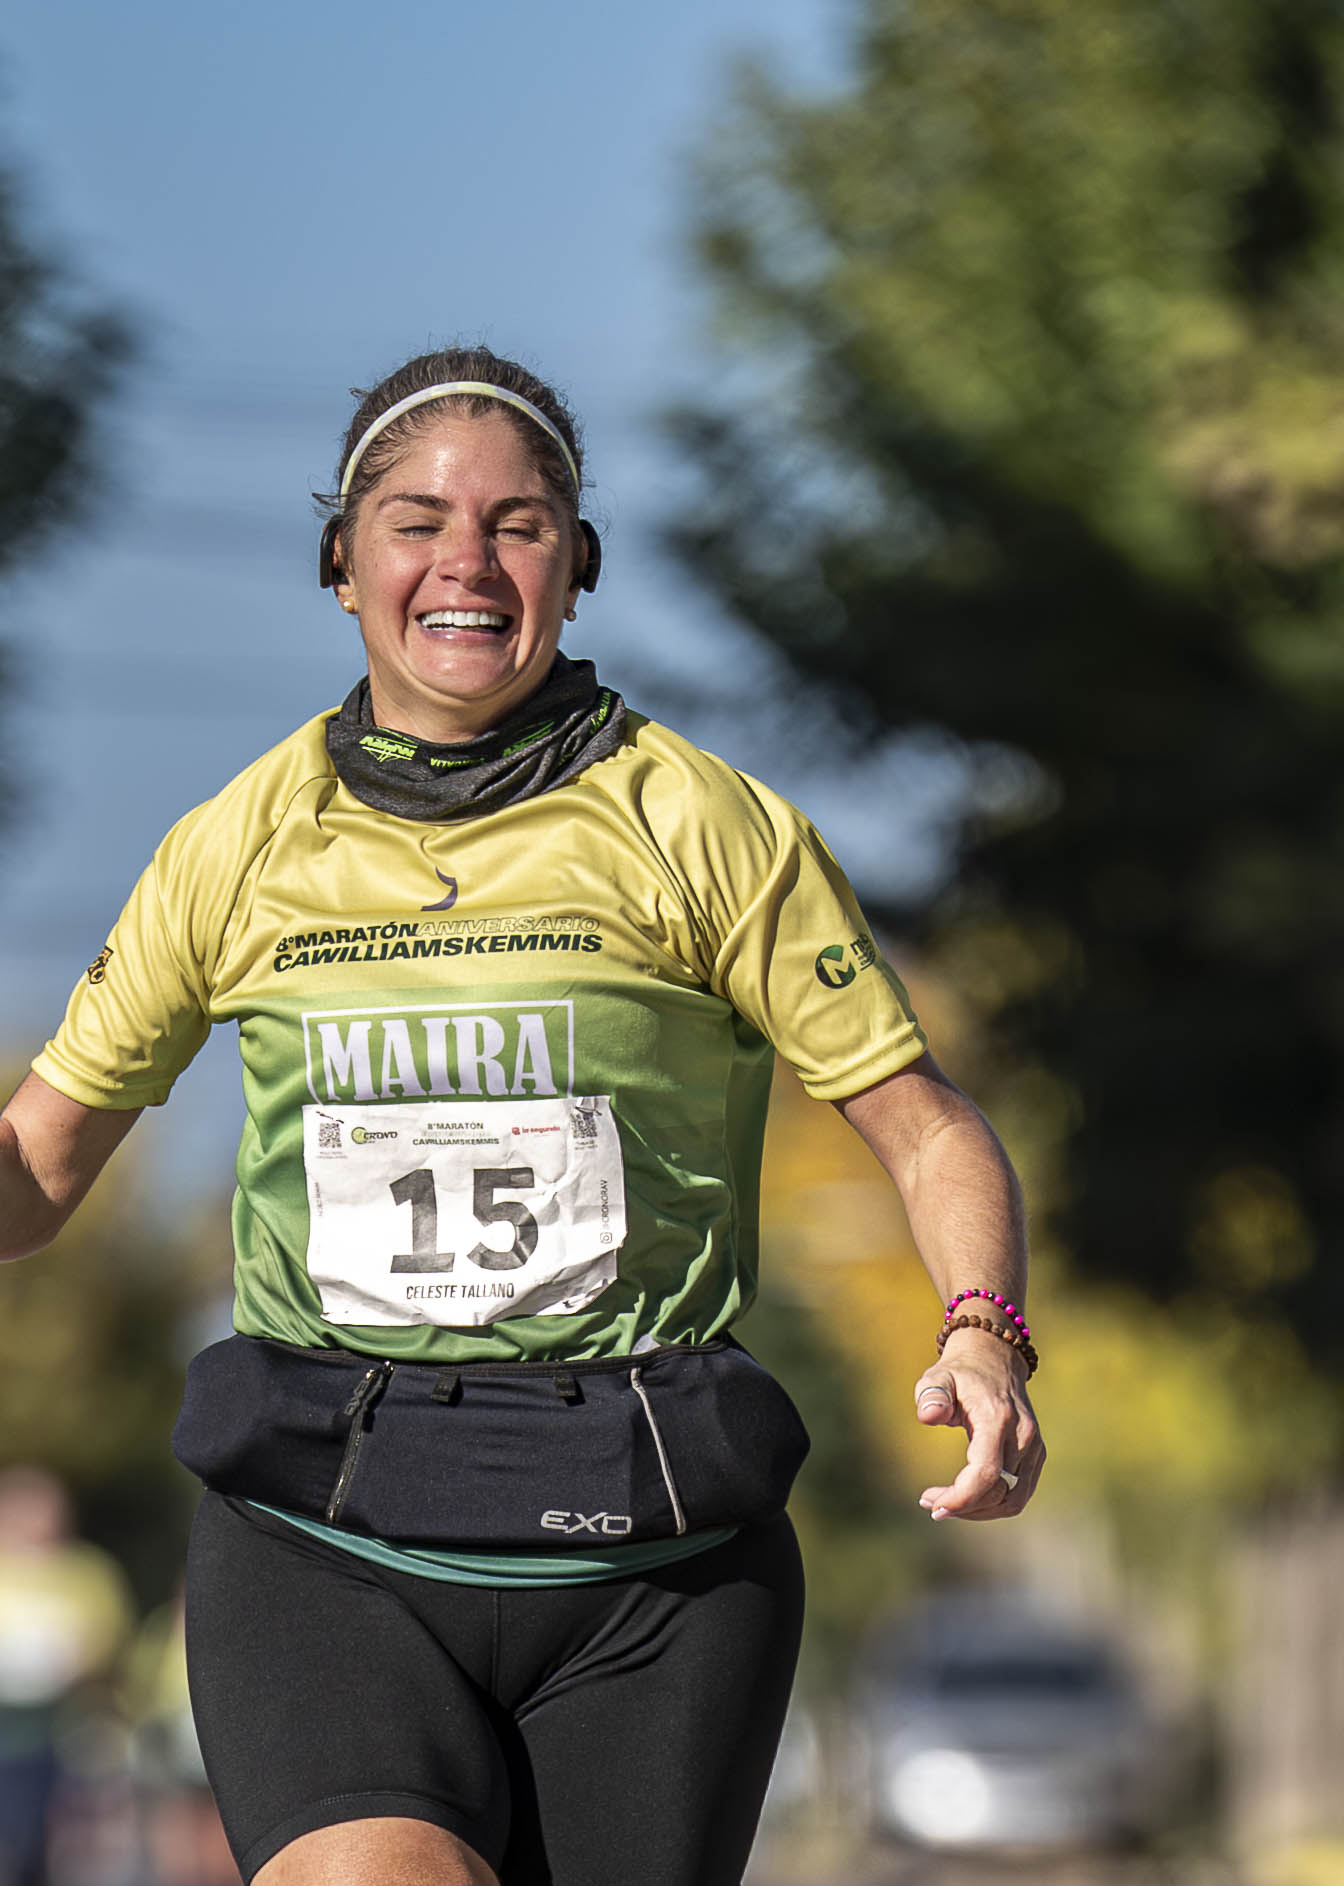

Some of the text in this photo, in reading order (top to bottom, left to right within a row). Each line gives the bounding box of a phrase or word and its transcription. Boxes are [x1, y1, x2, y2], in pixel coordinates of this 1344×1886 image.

[273, 934, 603, 973] CAWILLIAMSKEMMIS
[316, 1013, 557, 1102] MAIRA
[389, 1167, 539, 1273] 15
[406, 1284, 458, 1300] CELESTE
[540, 1509, 633, 1536] EXO
